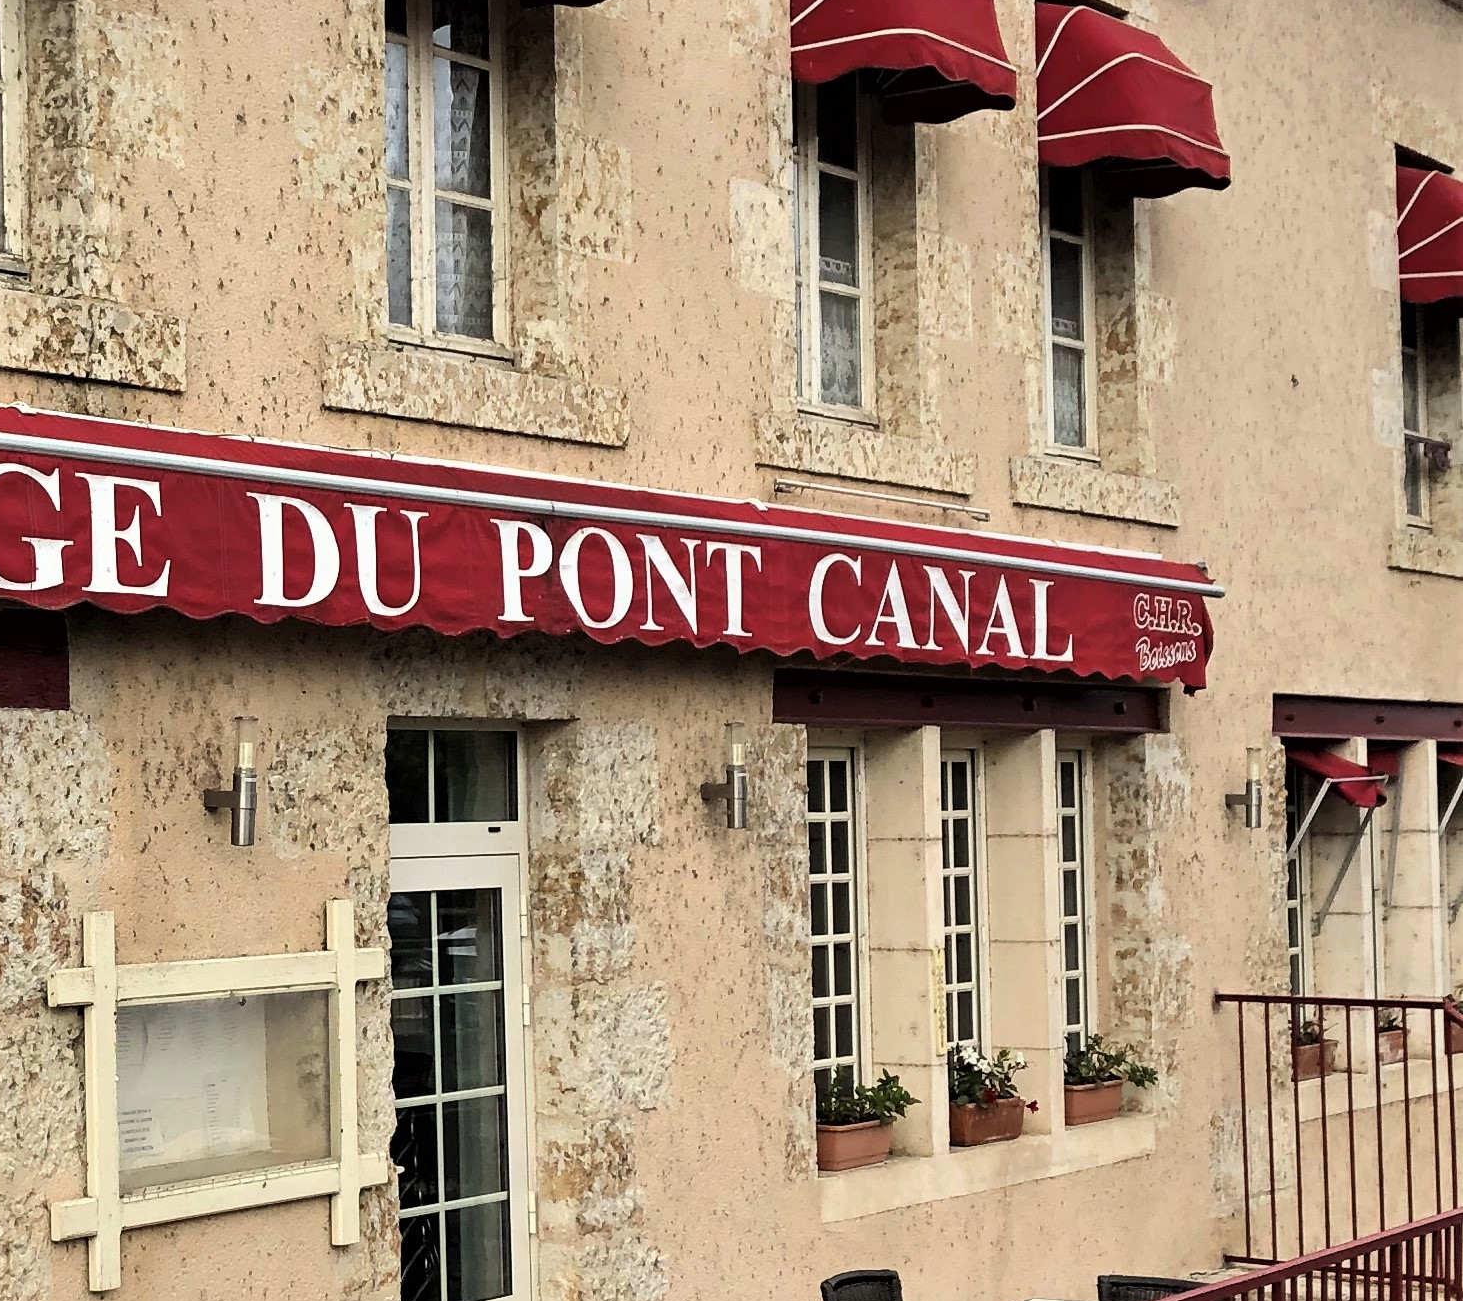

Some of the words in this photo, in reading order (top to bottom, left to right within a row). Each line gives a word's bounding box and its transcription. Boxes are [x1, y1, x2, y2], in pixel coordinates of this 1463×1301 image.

[246, 492, 429, 617] DU
[490, 518, 762, 637] PONT
[809, 553, 1074, 662] CANAL
[1133, 592, 1202, 636] C.H.R.
[1135, 636, 1197, 672] Boissons
